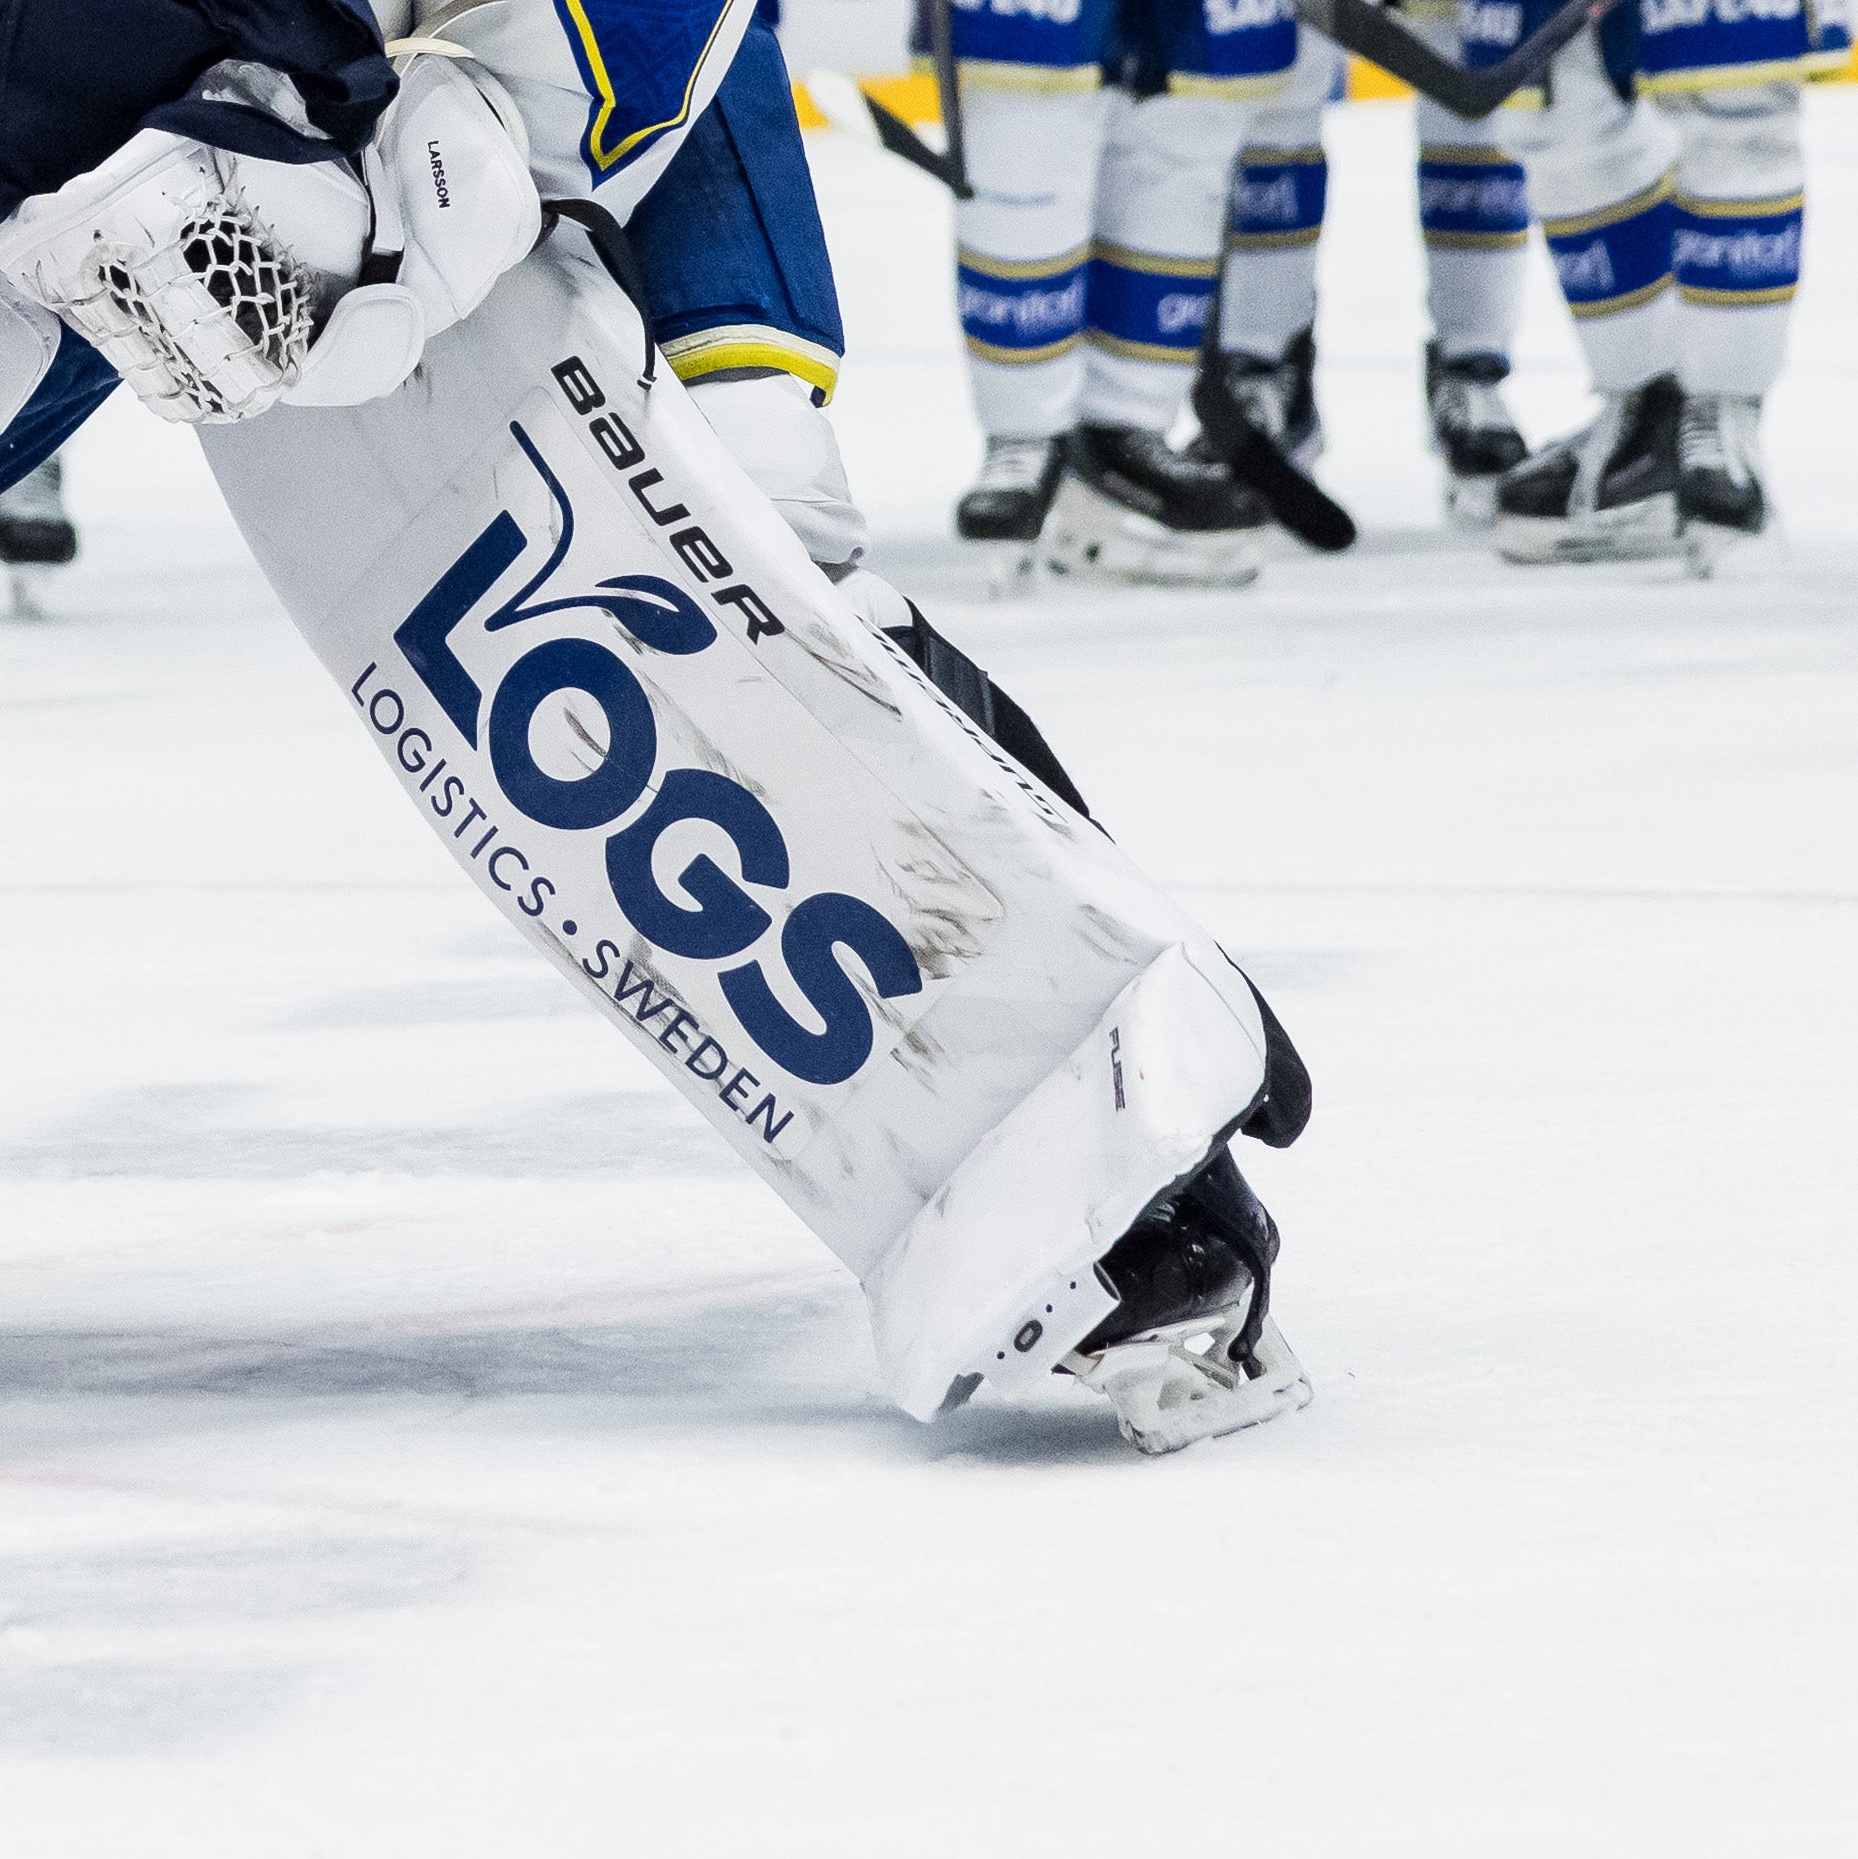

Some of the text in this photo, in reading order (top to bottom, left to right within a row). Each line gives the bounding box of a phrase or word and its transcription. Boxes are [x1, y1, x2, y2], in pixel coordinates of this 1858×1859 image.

[426, 138, 452, 211] LARSSON
[550, 355, 787, 644] BAUER
[350, 661, 796, 1144] LOGISTICS SWEDEN
[392, 508, 923, 1086] LOGS
